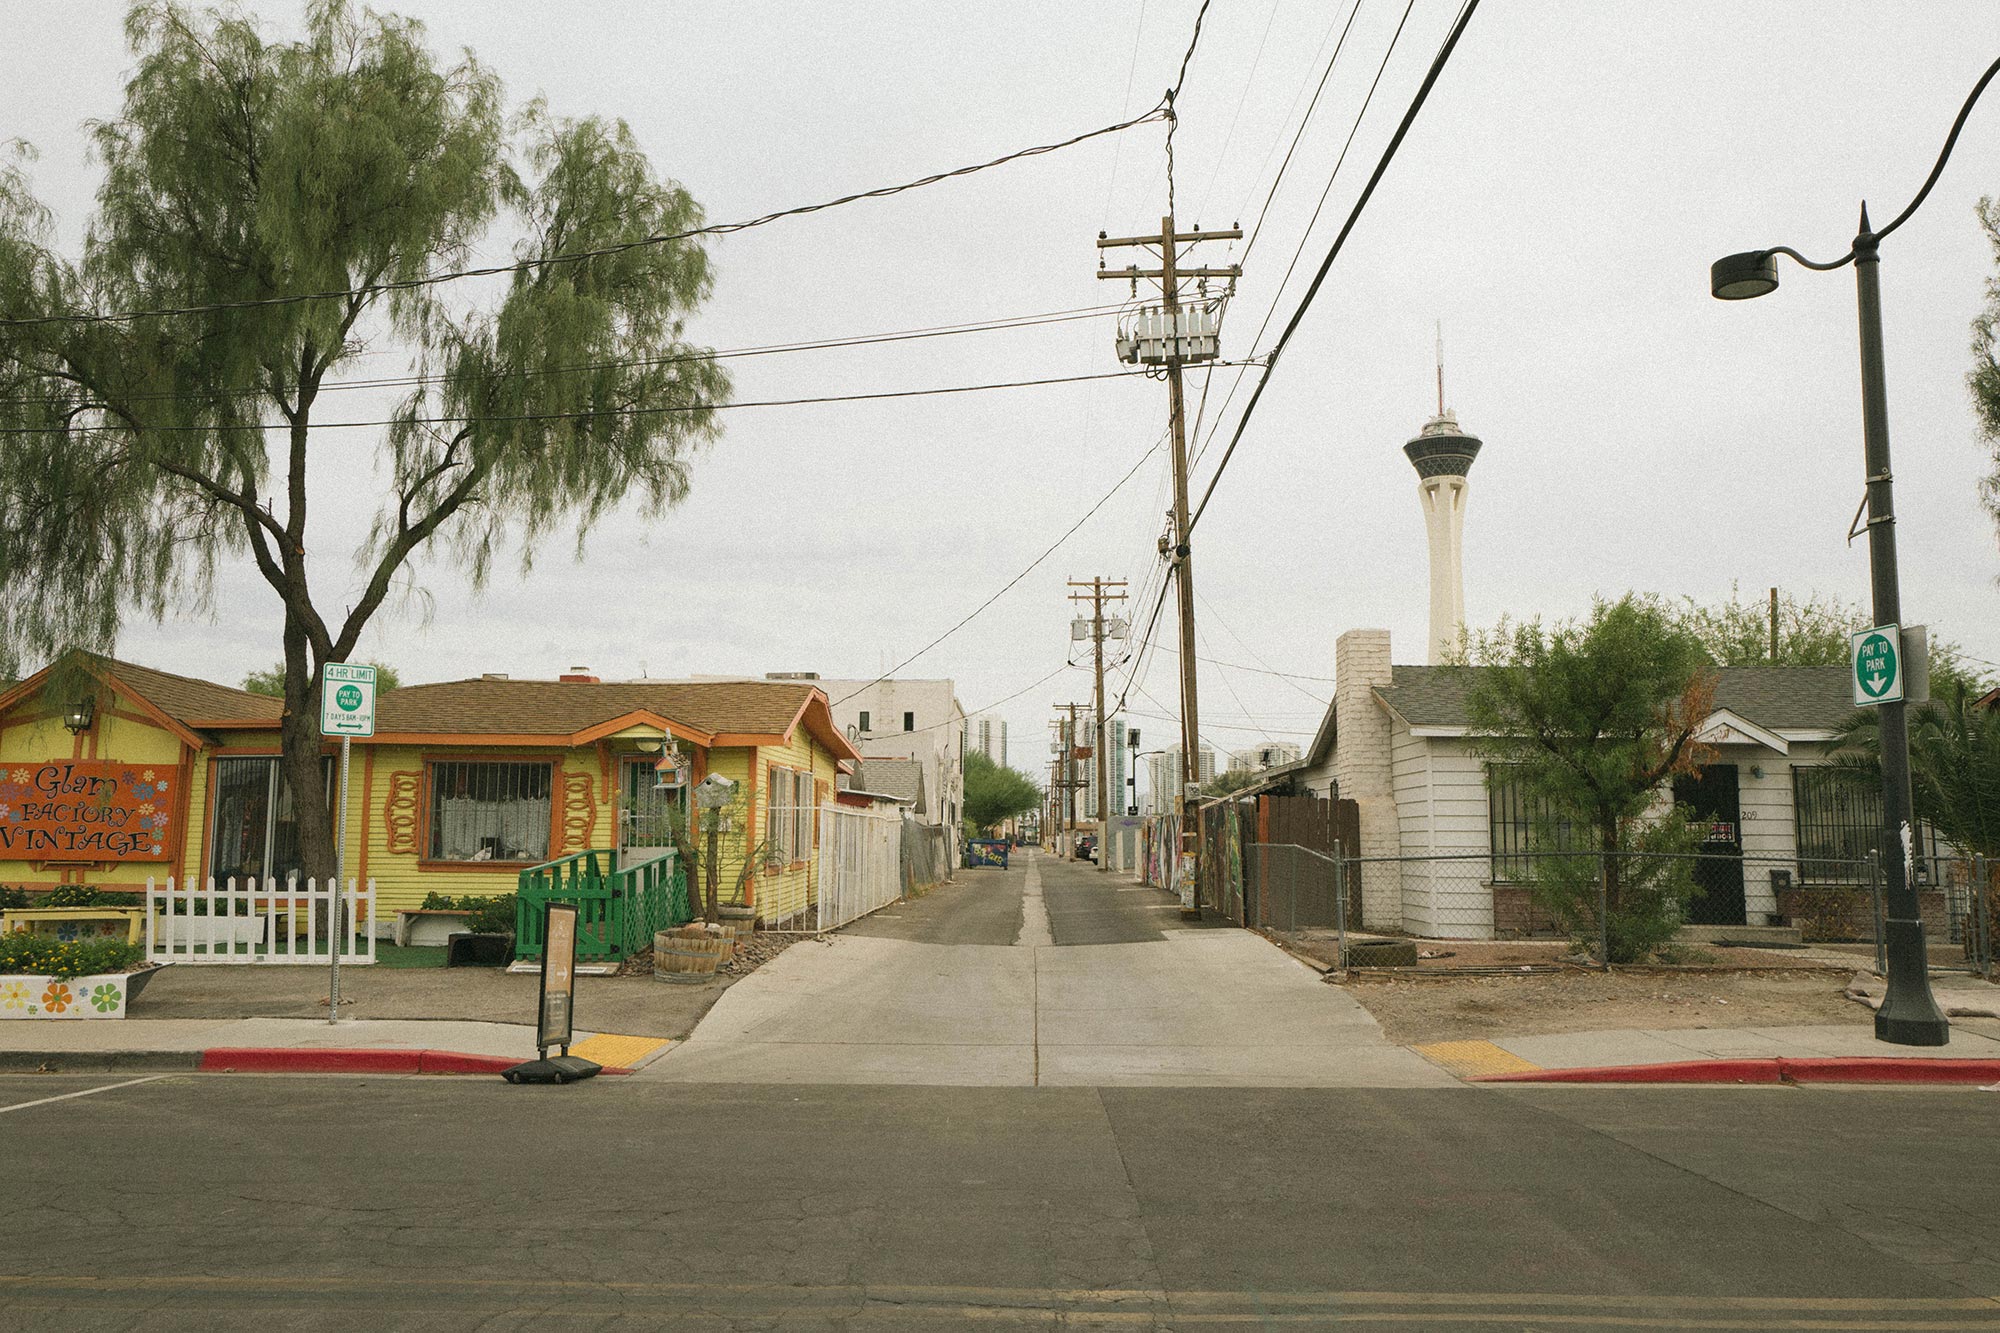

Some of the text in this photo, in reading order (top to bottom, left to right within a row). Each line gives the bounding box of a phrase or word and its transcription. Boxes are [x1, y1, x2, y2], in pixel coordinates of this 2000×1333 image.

[1862, 641, 1888, 658] PAY TO
[1866, 657, 1886, 672] PARK
[327, 667, 373, 680] 4 HR LIMIT
[338, 689, 360, 699] PAY TO
[340, 698, 358, 706] PARK
[330, 713, 346, 721] DAYS
[34, 764, 118, 799] Glam
[21, 801, 136, 827] FACTORY
[1741, 810, 1758, 821] 209
[0, 825, 152, 856] VINTAGE
